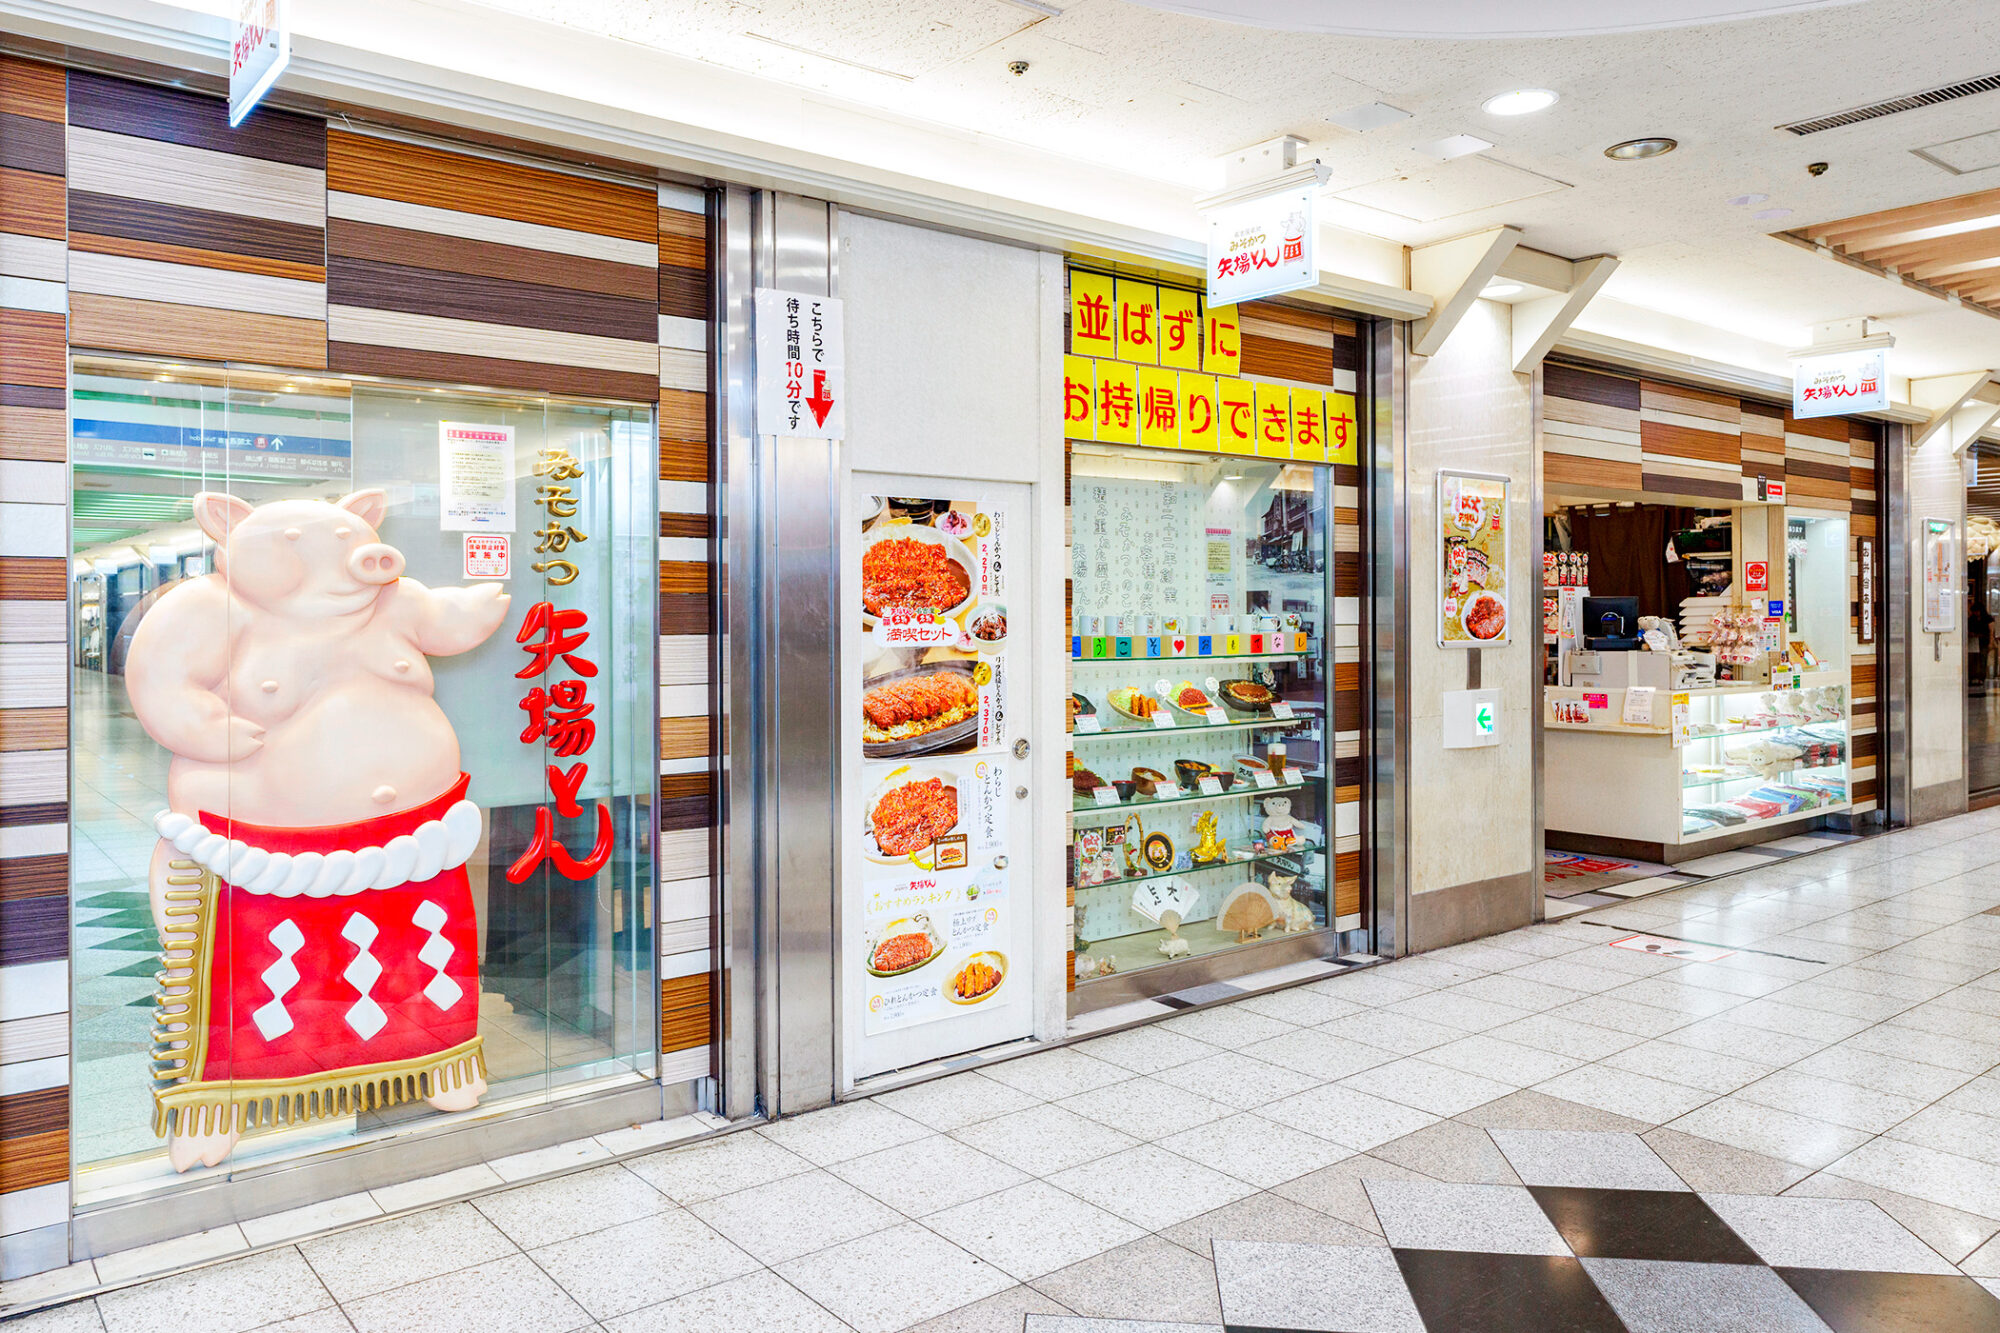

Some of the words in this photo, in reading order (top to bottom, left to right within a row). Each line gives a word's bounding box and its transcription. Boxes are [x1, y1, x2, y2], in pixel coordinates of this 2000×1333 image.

[1228, 234, 1267, 252] みそかつ
[1217, 245, 1280, 280] 矢場とん
[810, 302, 825, 363] こちらで
[1076, 292, 1238, 358] 並ばずに
[785, 297, 804, 430] 待ち時間10分です
[1813, 375, 1846, 385] みそかつ
[1803, 384, 1858, 402] 矢場とん
[1064, 375, 1354, 450] お持帰りできます
[531, 447, 588, 586] みそかつ
[886, 626, 953, 643] 満喫セット
[506, 601, 613, 883] 矢場とん
[993, 766, 1003, 798] わらじ
[983, 774, 994, 838] とんかつ定食
[875, 888, 954, 912] おすすめランキング
[952, 922, 990, 936] とんかつ定食
[883, 986, 938, 1006] ひれとんかつ定食
